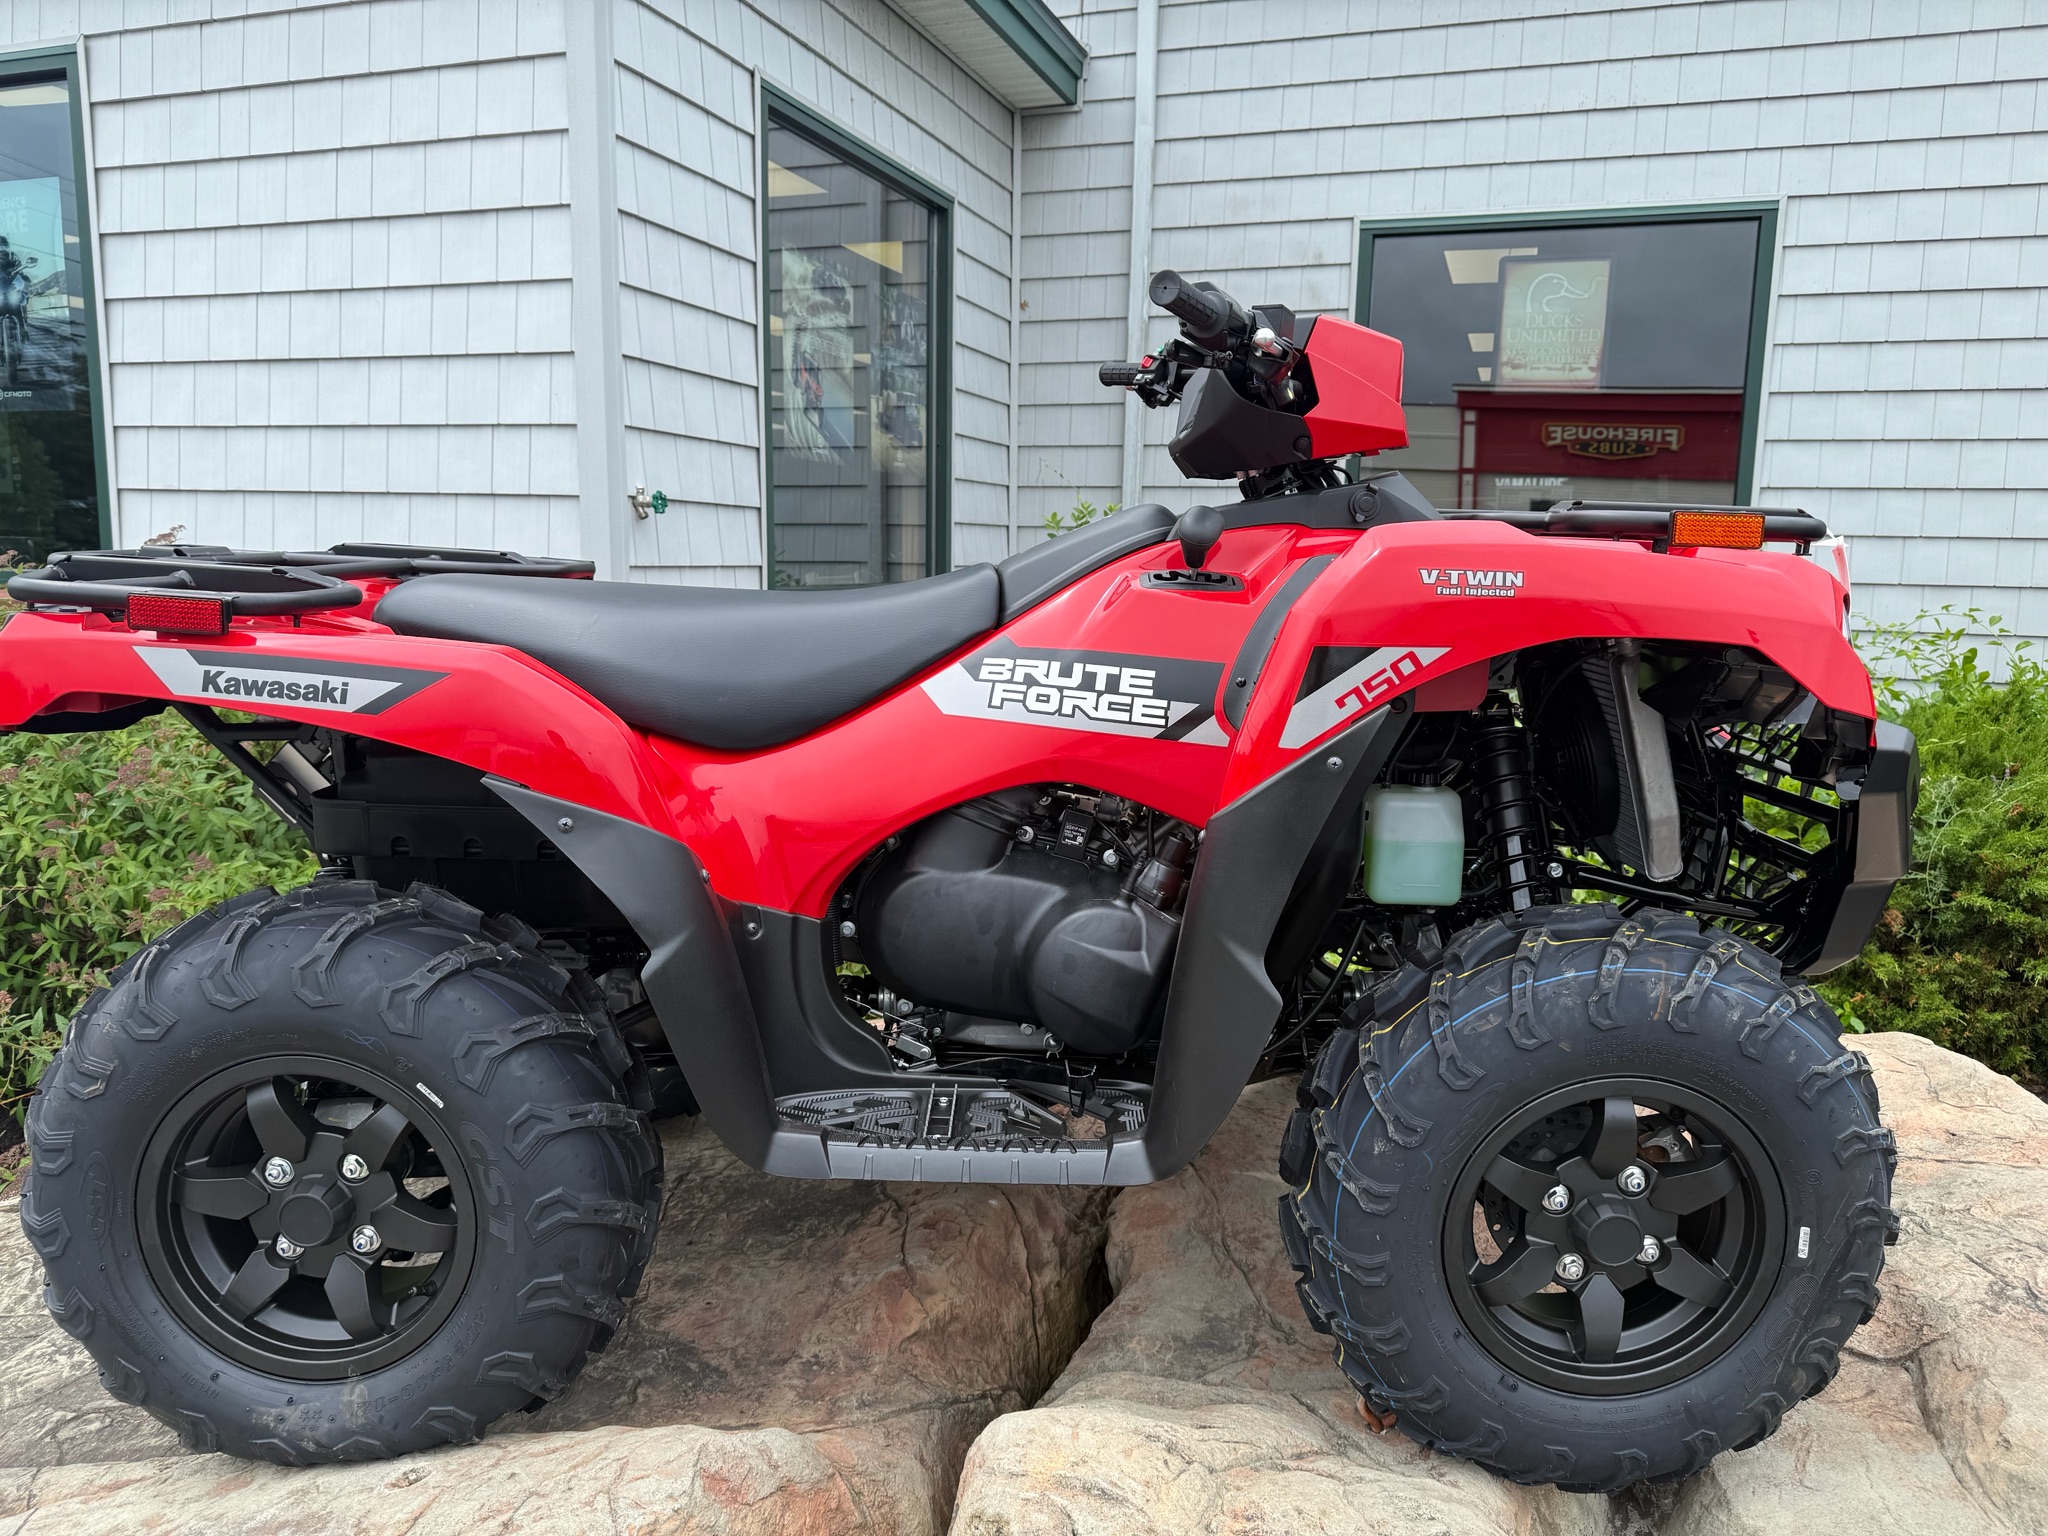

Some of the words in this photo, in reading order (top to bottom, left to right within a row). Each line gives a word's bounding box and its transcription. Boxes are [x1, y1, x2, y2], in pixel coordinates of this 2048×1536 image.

[1525, 313, 1585, 328] DUCKS
[1506, 328, 1601, 343] UNLIMITED
[4, 390, 32, 398] CFMOTO
[1418, 568, 1525, 588] V-TWIN
[1436, 586, 1461, 596] Fuel
[1465, 586, 1515, 597] Injected
[201, 669, 350, 705] Kawasaki
[977, 657, 1157, 697] BRUTE
[1334, 650, 1424, 711] 750
[987, 682, 1169, 728] FORCE
[458, 1121, 515, 1255] CST
[1741, 1274, 1821, 1392] CST
[1603, 1404, 1642, 1415] TUBELESS
